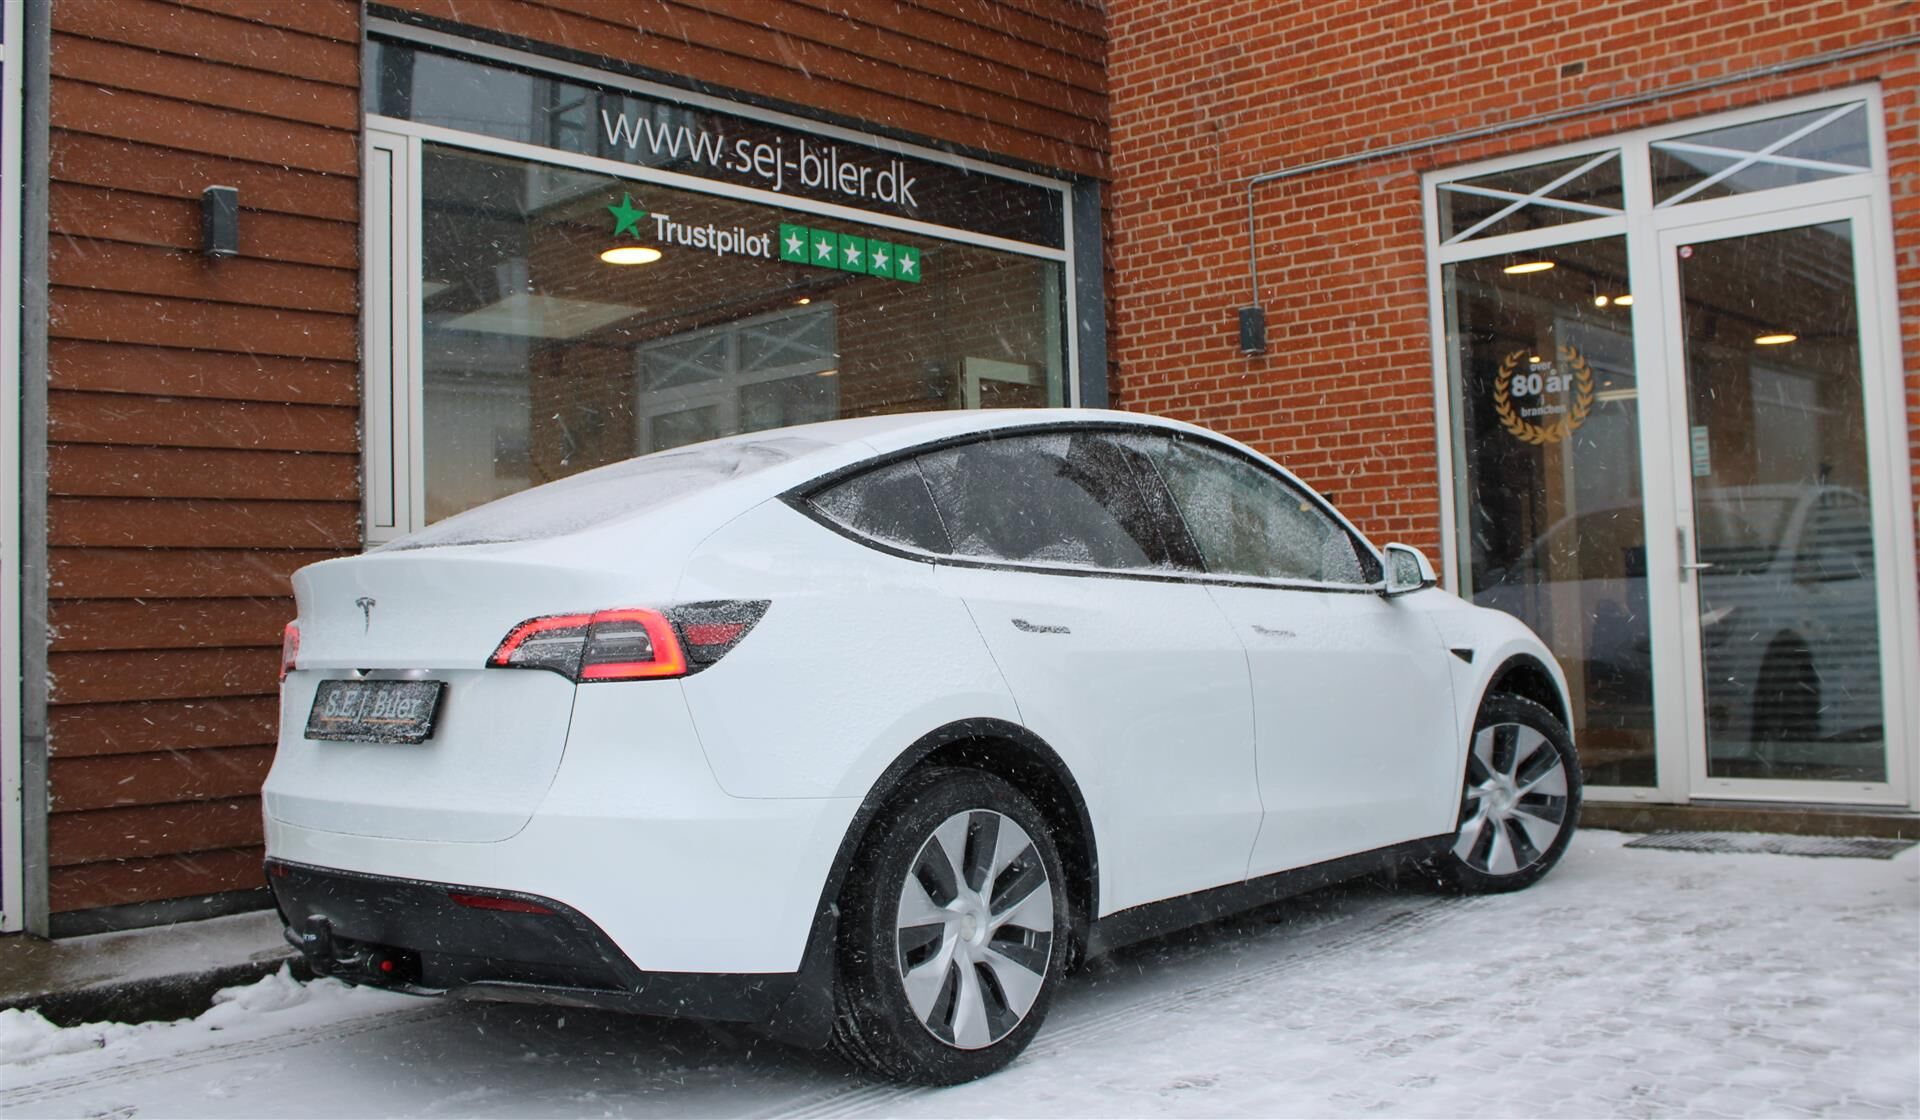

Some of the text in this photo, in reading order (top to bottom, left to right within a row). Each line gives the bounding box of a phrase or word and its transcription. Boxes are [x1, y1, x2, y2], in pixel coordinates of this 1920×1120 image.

[602, 109, 917, 207] www.sej-biler.dk
[651, 212, 771, 258] Trustpilot
[1512, 369, 1573, 396] 80 år
[371, 691, 421, 717] Biler
